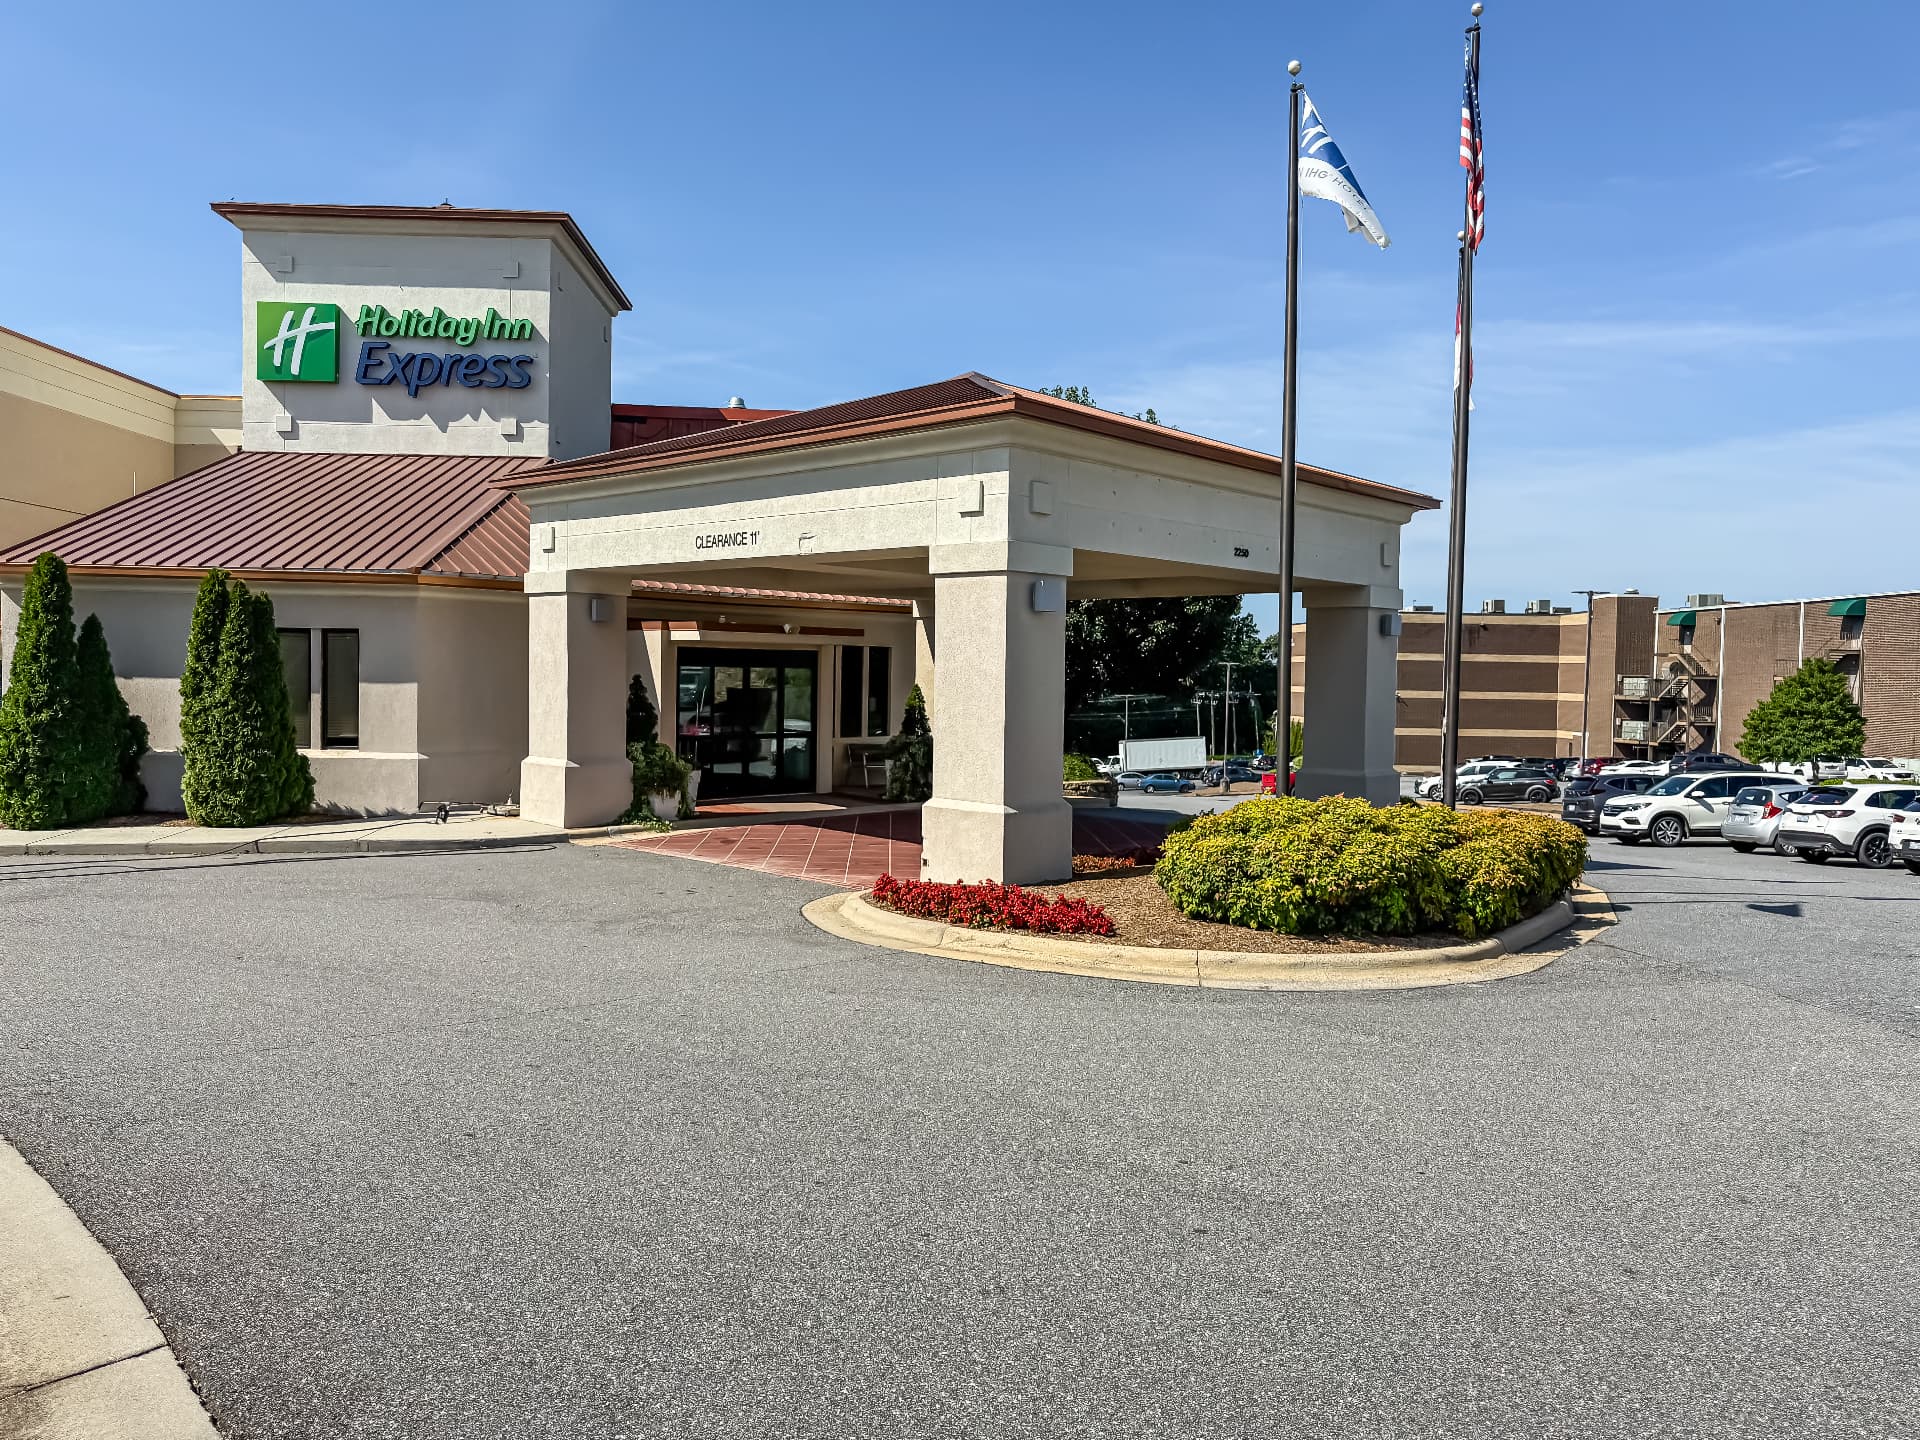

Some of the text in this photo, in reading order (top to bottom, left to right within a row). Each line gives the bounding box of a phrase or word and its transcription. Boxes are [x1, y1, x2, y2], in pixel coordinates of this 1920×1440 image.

[1305, 167, 1329, 179] IHG
[355, 305, 535, 347] Holiday Inn
[354, 341, 534, 398] Express
[695, 530, 760, 549] CLEARANCE 11'
